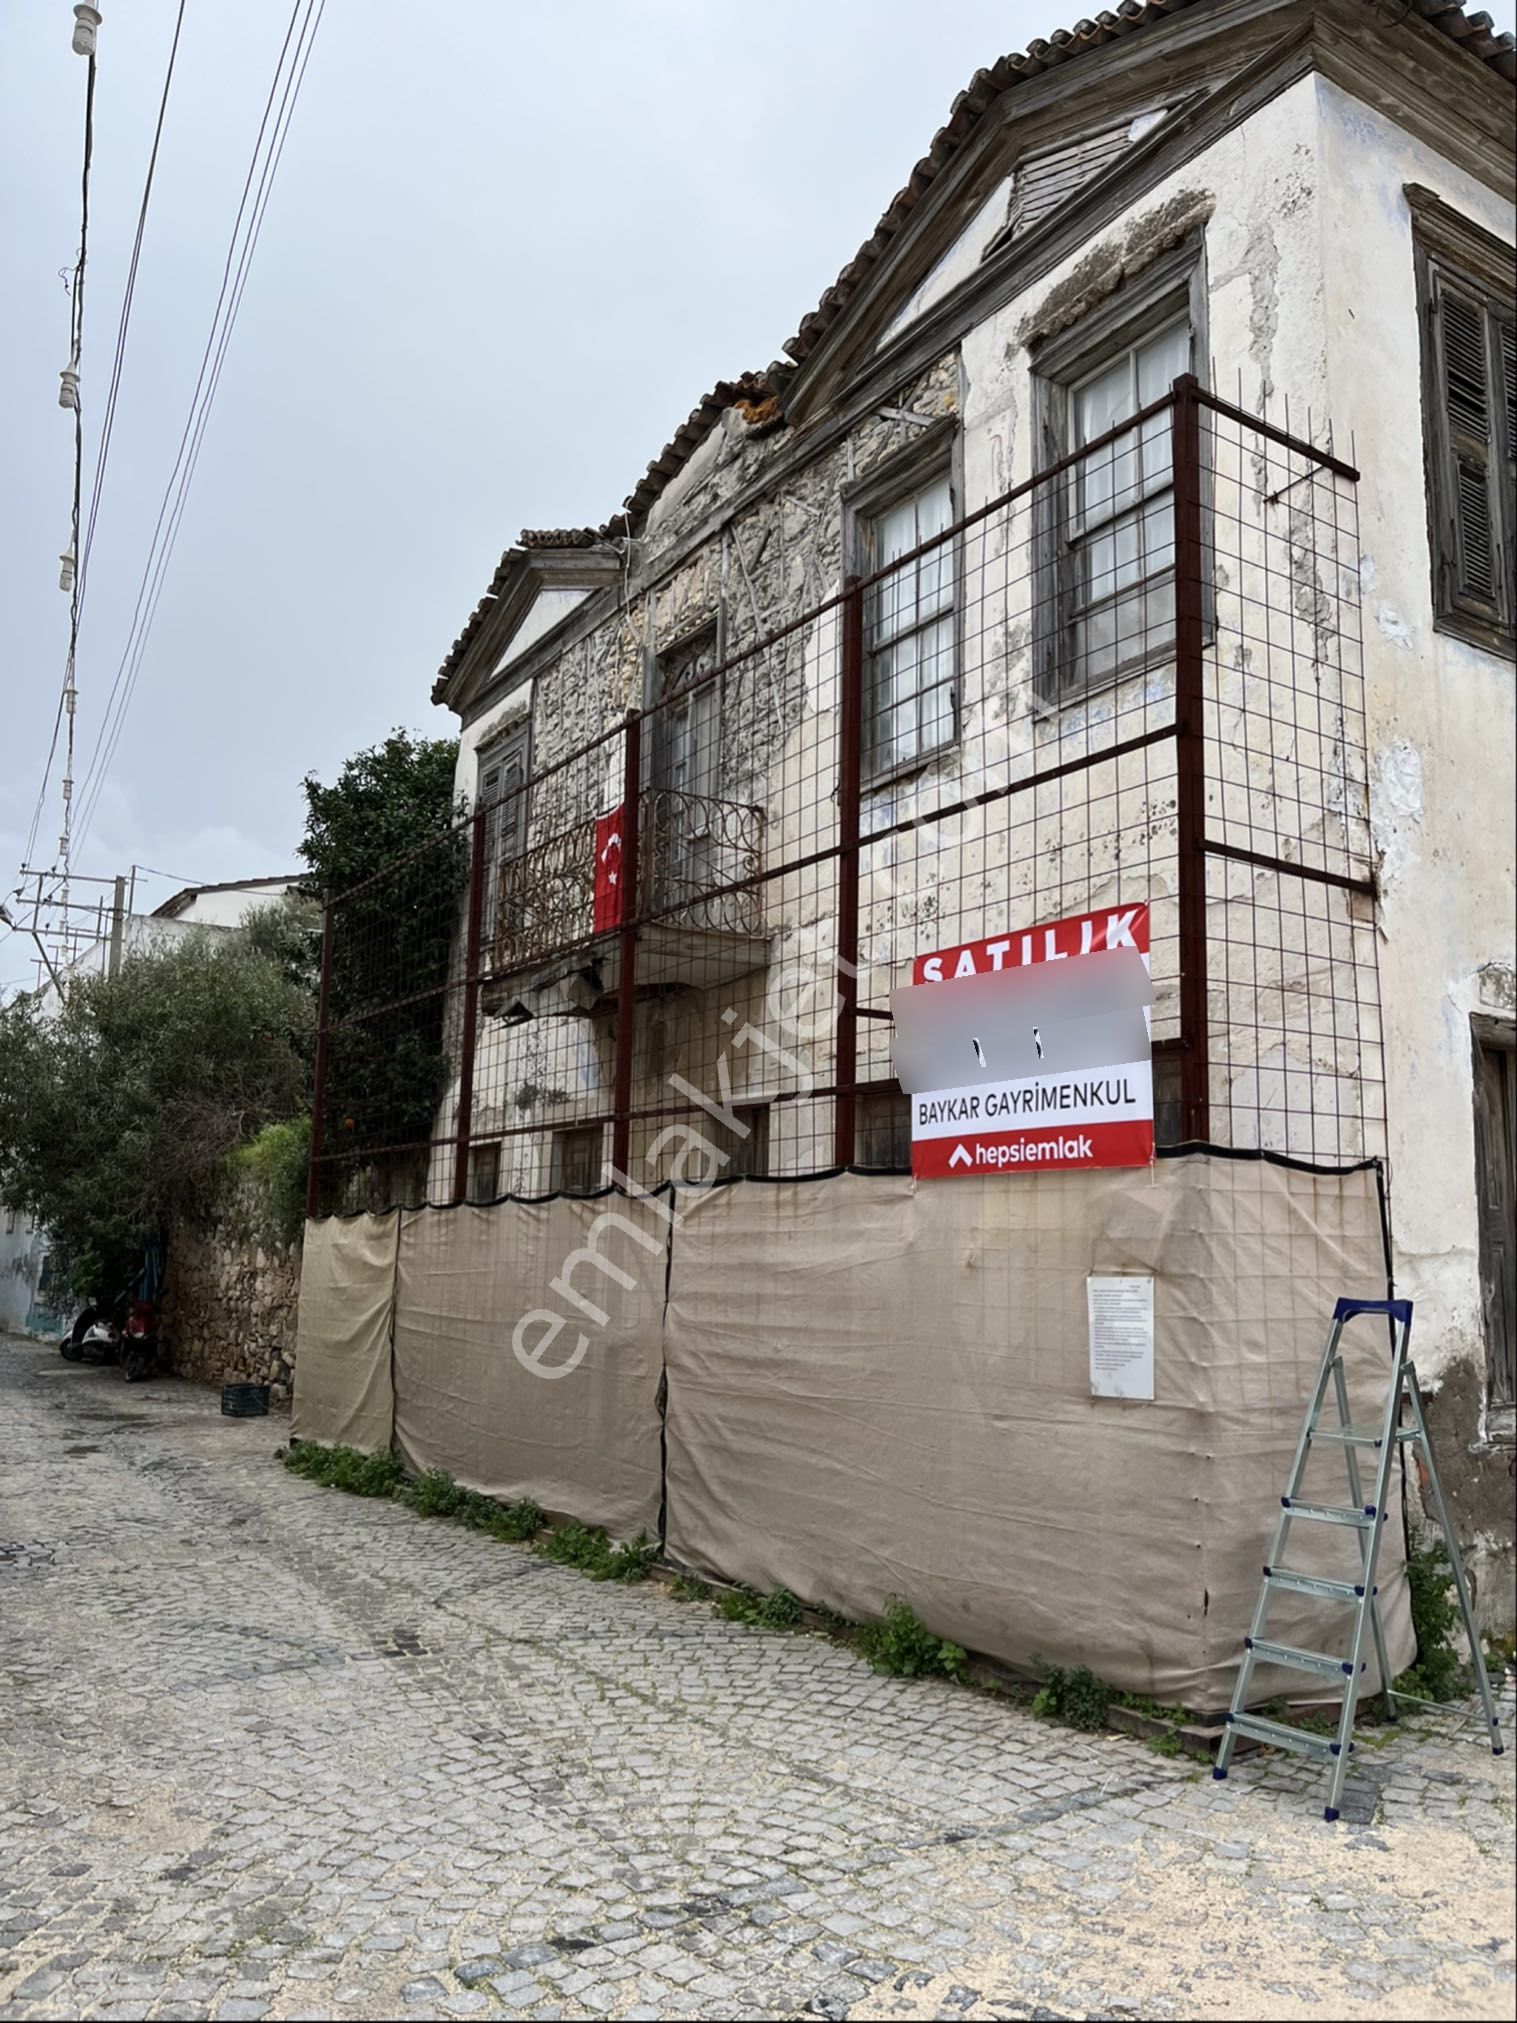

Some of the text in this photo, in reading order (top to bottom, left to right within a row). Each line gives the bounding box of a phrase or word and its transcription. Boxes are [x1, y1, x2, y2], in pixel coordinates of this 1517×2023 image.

[923, 909, 1138, 983] SATILIK
[919, 1078, 1136, 1125] BAYKAR GAYRİMENKUL
[976, 1134, 1093, 1168] hepsiemlak
